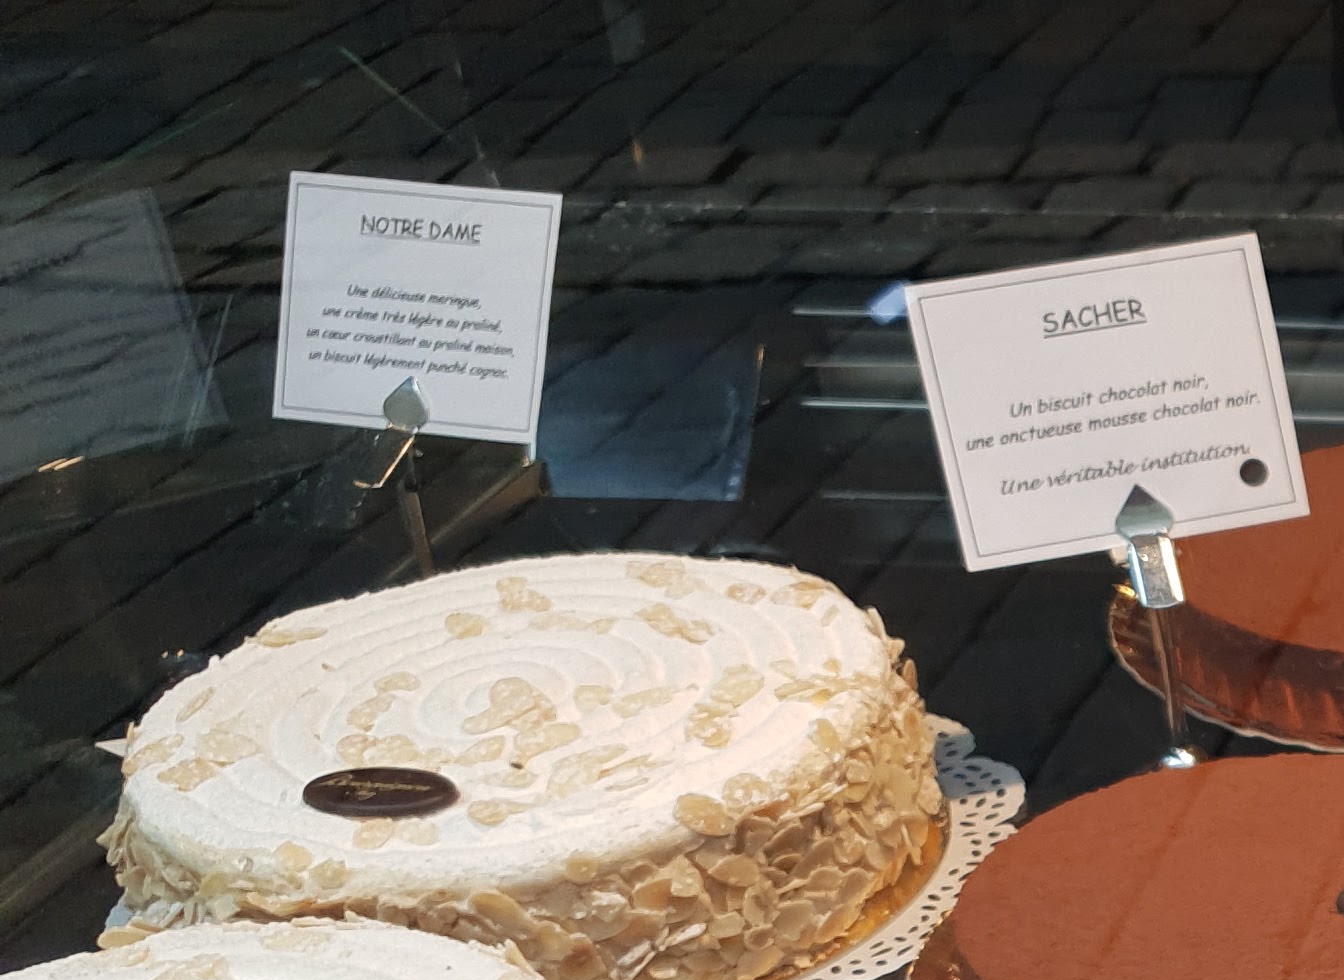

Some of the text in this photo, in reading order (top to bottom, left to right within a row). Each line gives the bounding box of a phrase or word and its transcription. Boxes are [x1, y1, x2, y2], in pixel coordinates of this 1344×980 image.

[360, 214, 483, 244] NOTRE DAME
[1042, 298, 1146, 334] SACHER
[1009, 373, 1209, 419] Un biscuit chocolat noir,
[965, 390, 1261, 452] une onctueuse mousse chocolat noir.
